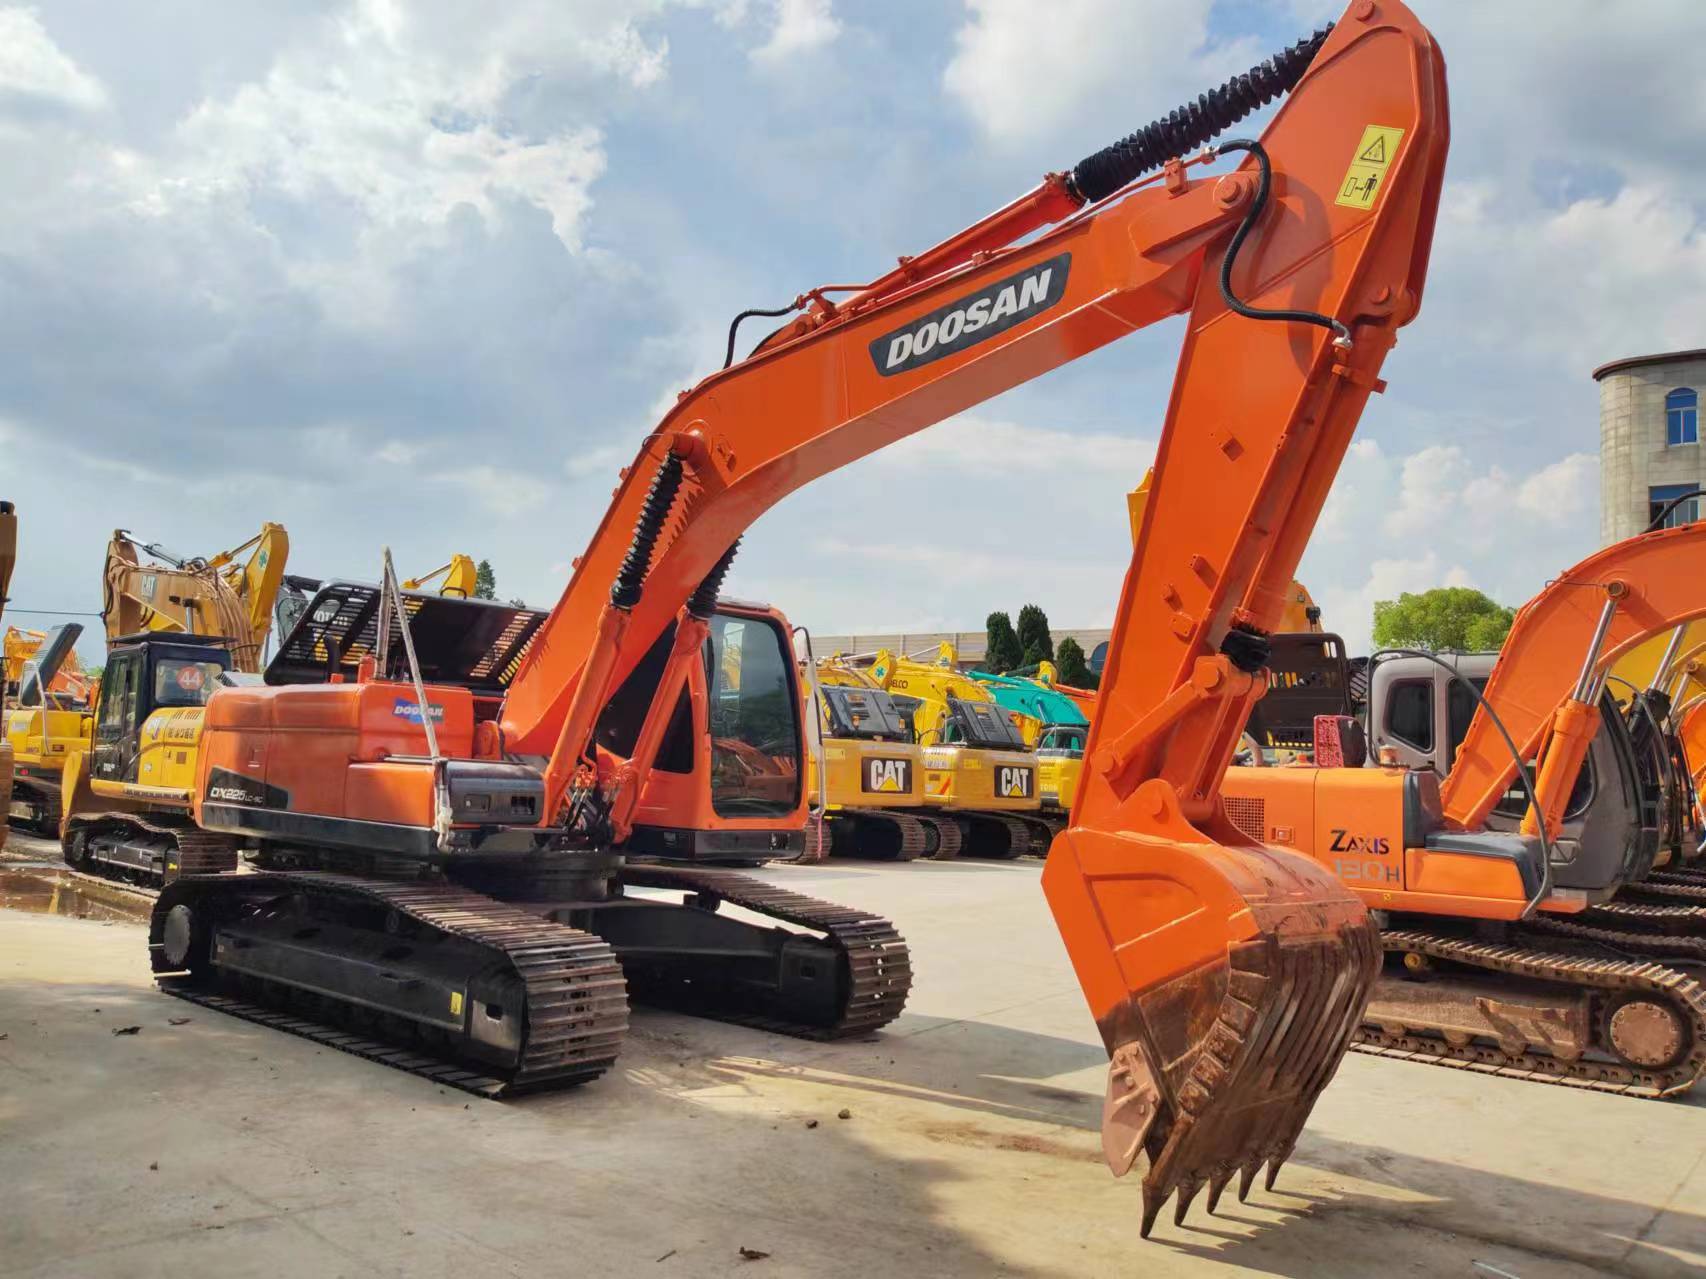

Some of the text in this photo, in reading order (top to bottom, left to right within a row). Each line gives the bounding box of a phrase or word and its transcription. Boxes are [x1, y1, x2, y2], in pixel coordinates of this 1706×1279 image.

[886, 268, 1052, 369] DOOSAN
[181, 671, 201, 688] 44
[394, 705, 443, 716] DOOAN
[871, 759, 906, 791] CAT
[1001, 767, 1028, 797] CAT
[1330, 830, 1389, 855] ZAXIS
